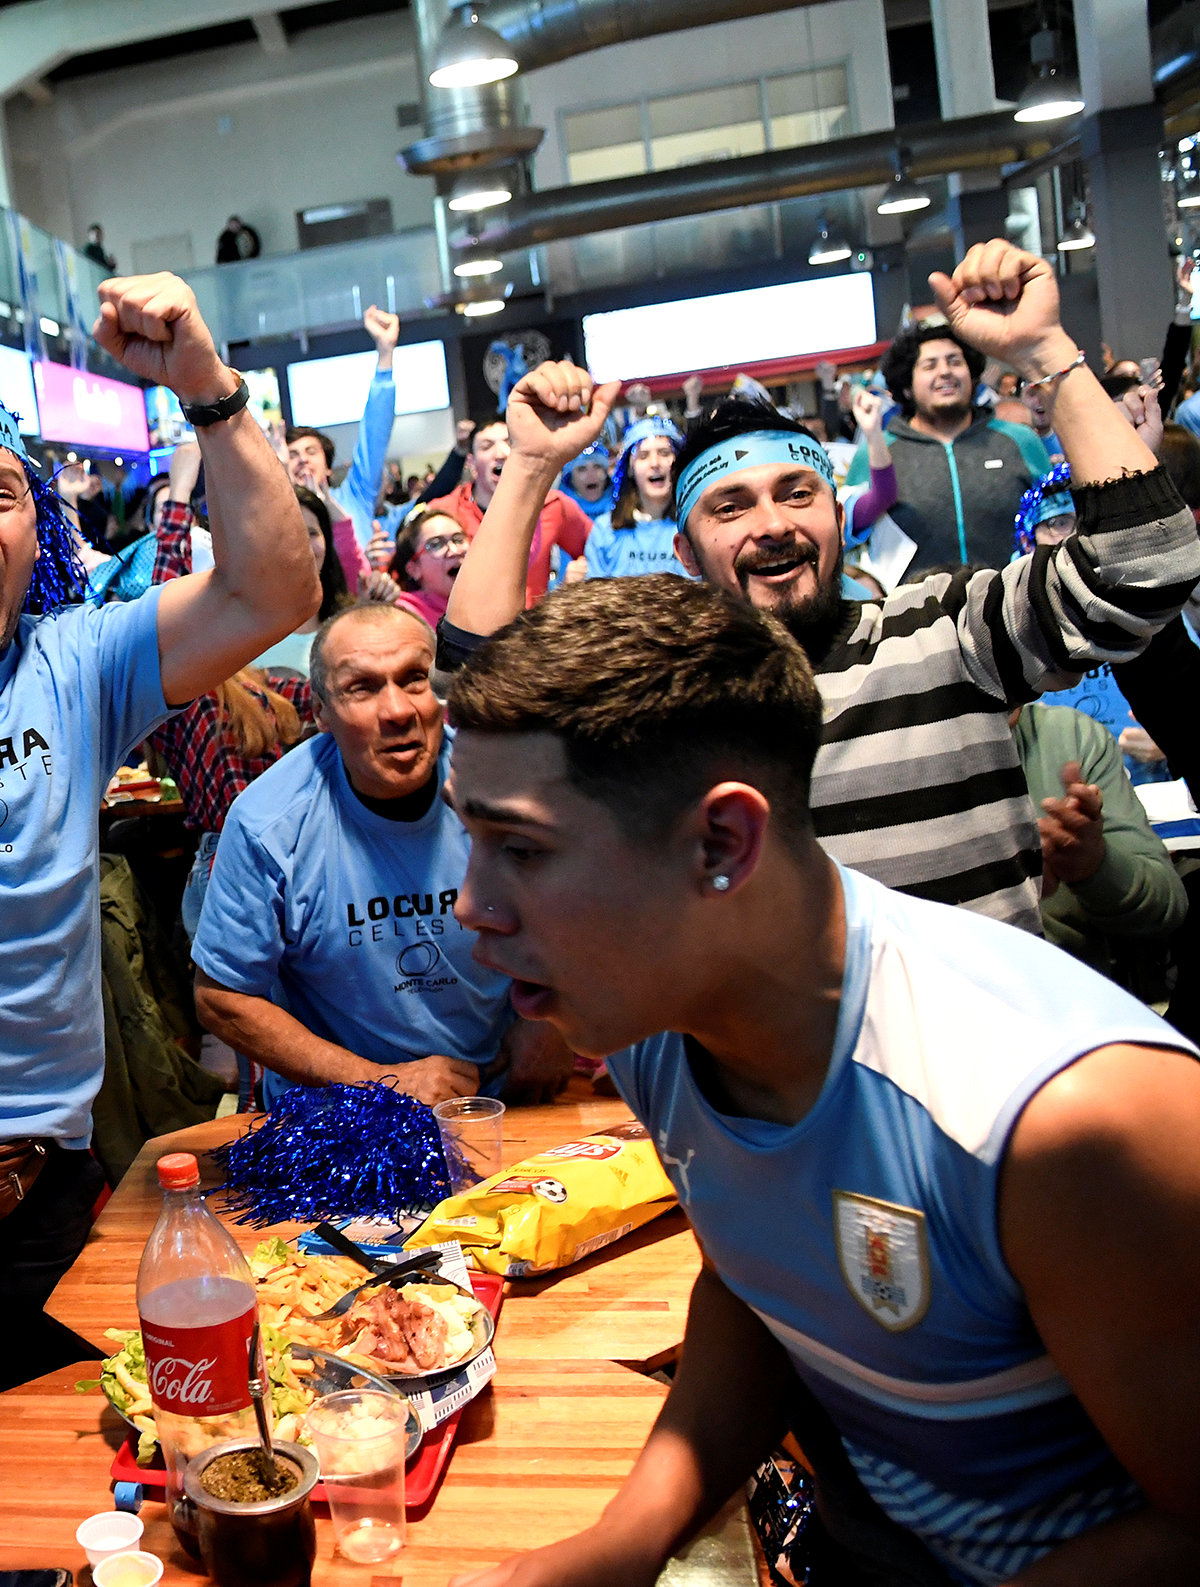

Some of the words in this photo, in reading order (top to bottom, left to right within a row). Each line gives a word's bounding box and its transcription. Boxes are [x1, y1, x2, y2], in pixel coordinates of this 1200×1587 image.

[347, 888, 458, 926] LOCUR
[349, 919, 463, 947] CELES
[394, 978, 424, 993] MONTE
[426, 977, 458, 987] CARLO
